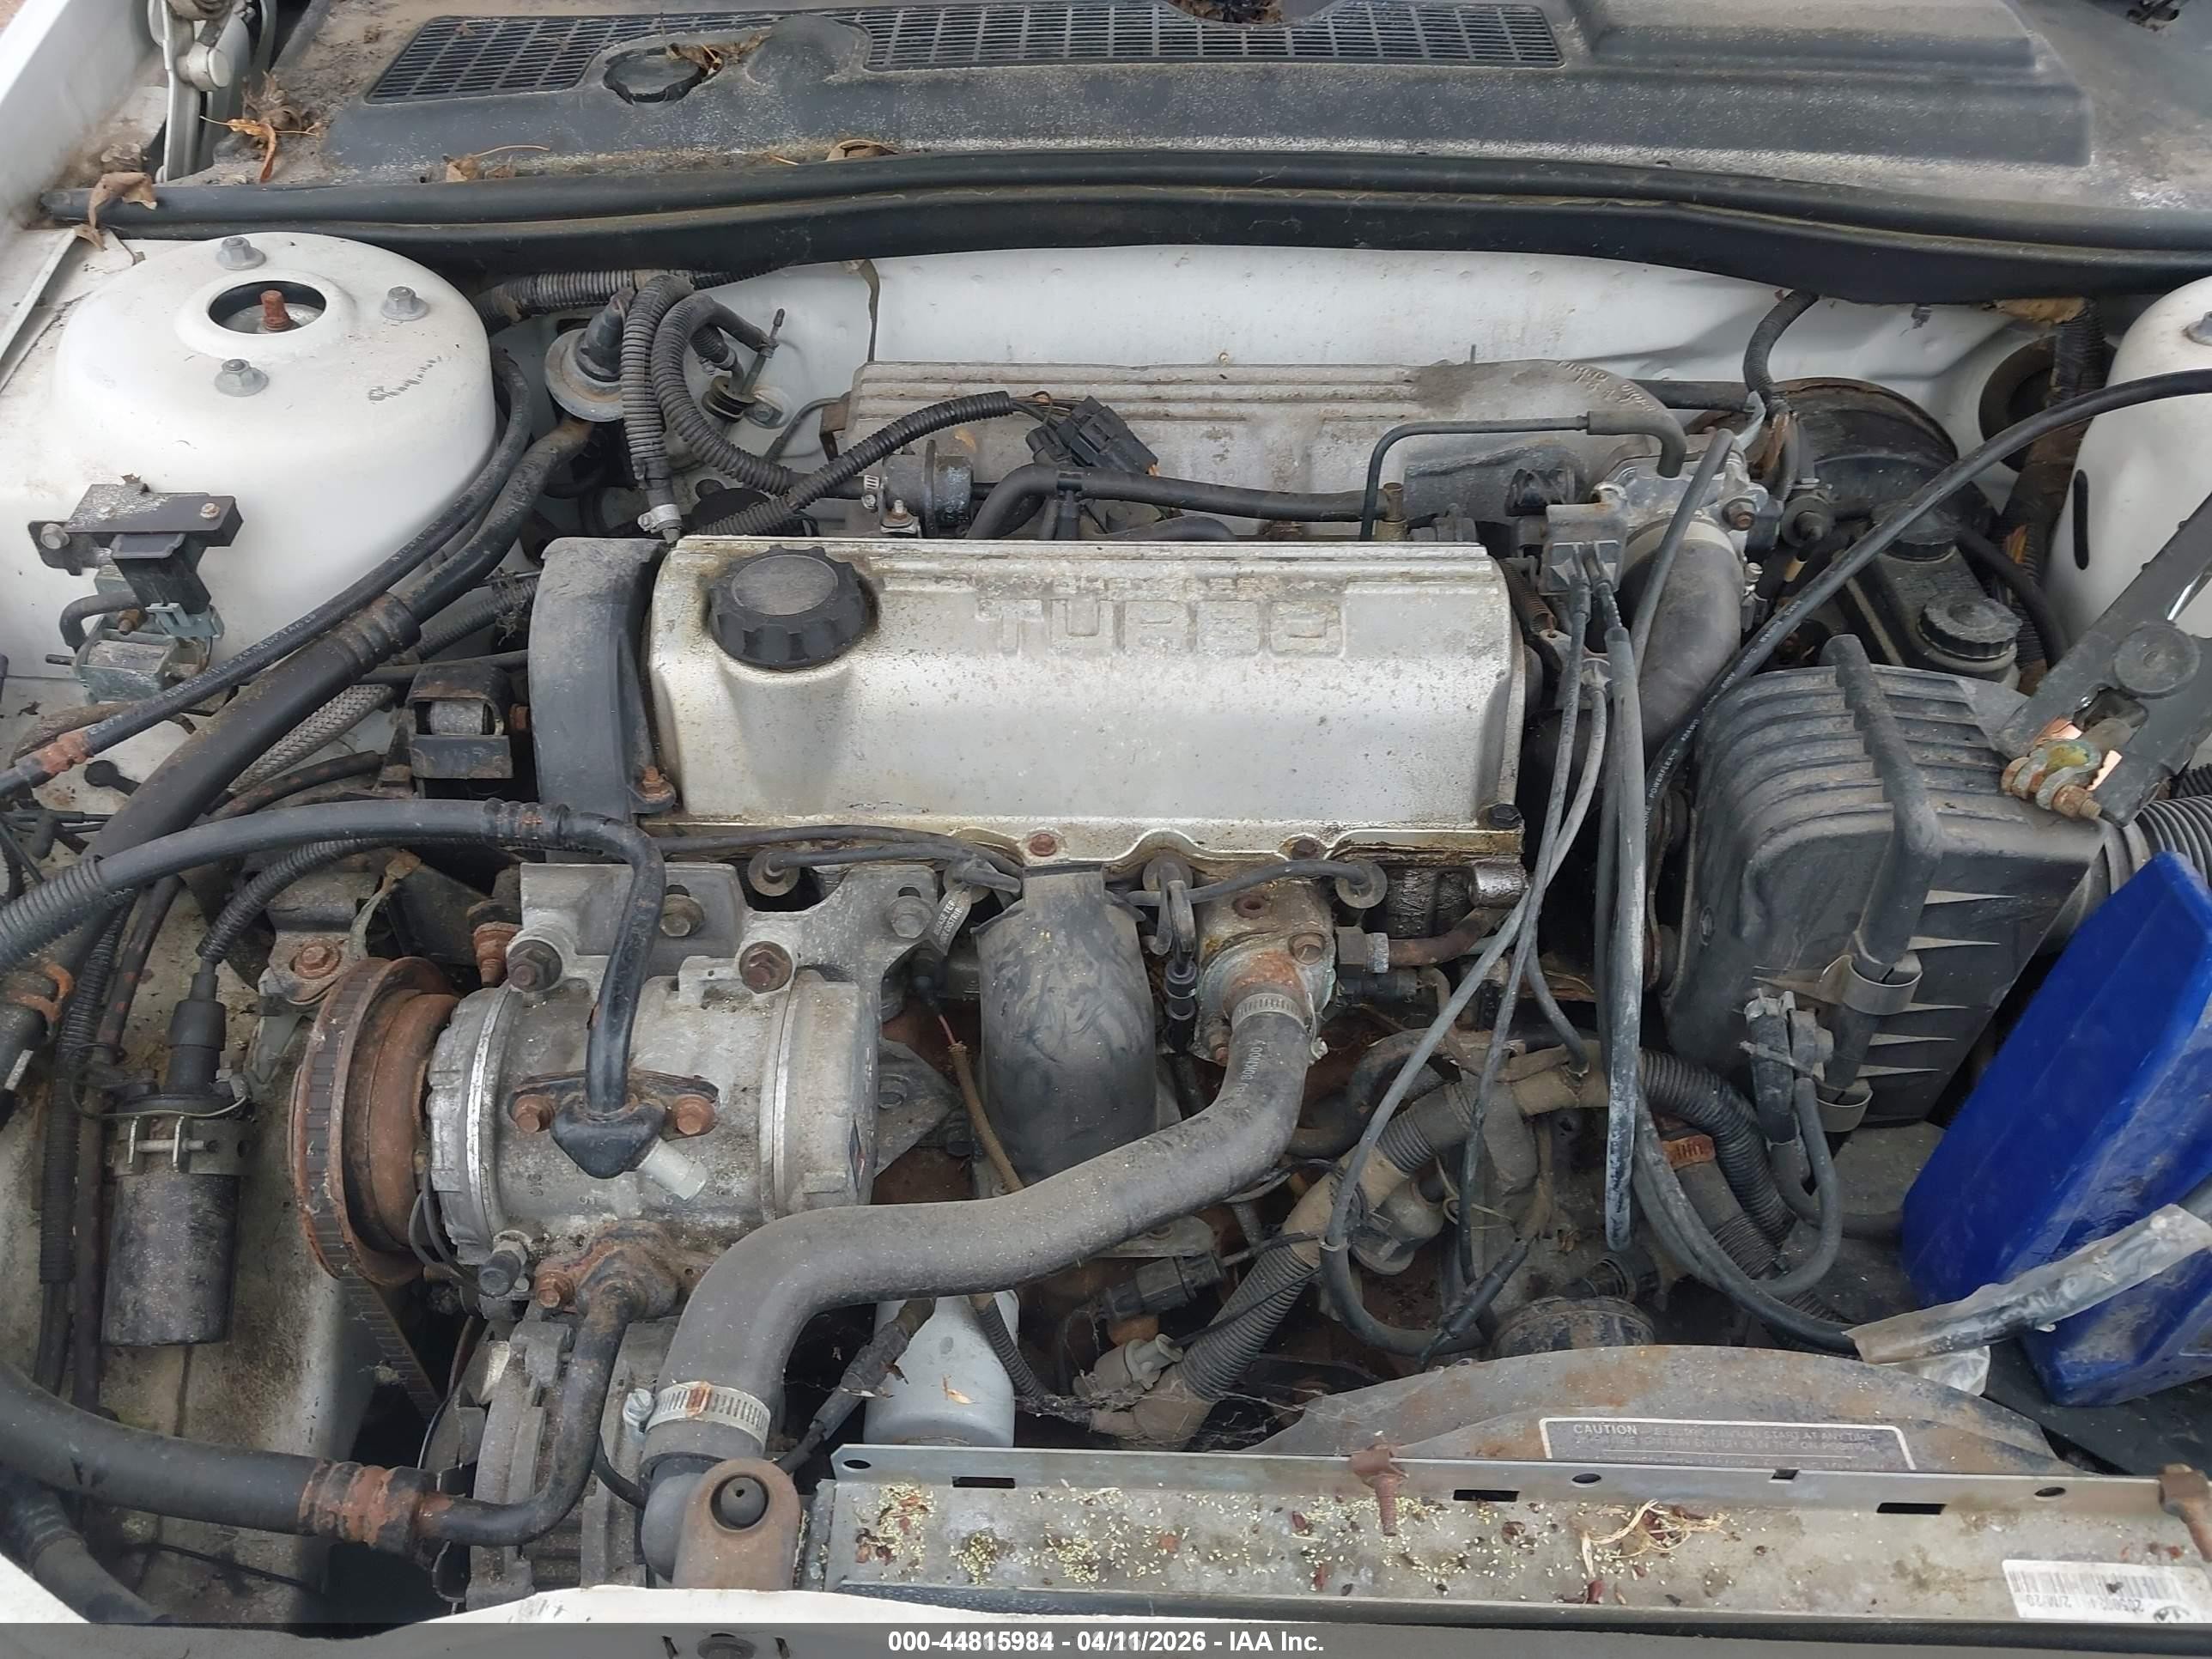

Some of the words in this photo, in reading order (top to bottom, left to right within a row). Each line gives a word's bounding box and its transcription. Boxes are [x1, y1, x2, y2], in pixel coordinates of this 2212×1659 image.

[975, 599, 1345, 658] TURBO
[1573, 1423, 1638, 1436] CAUTION
[1765, 1431, 1801, 1441] START
[1802, 1431, 1817, 1440] AT
